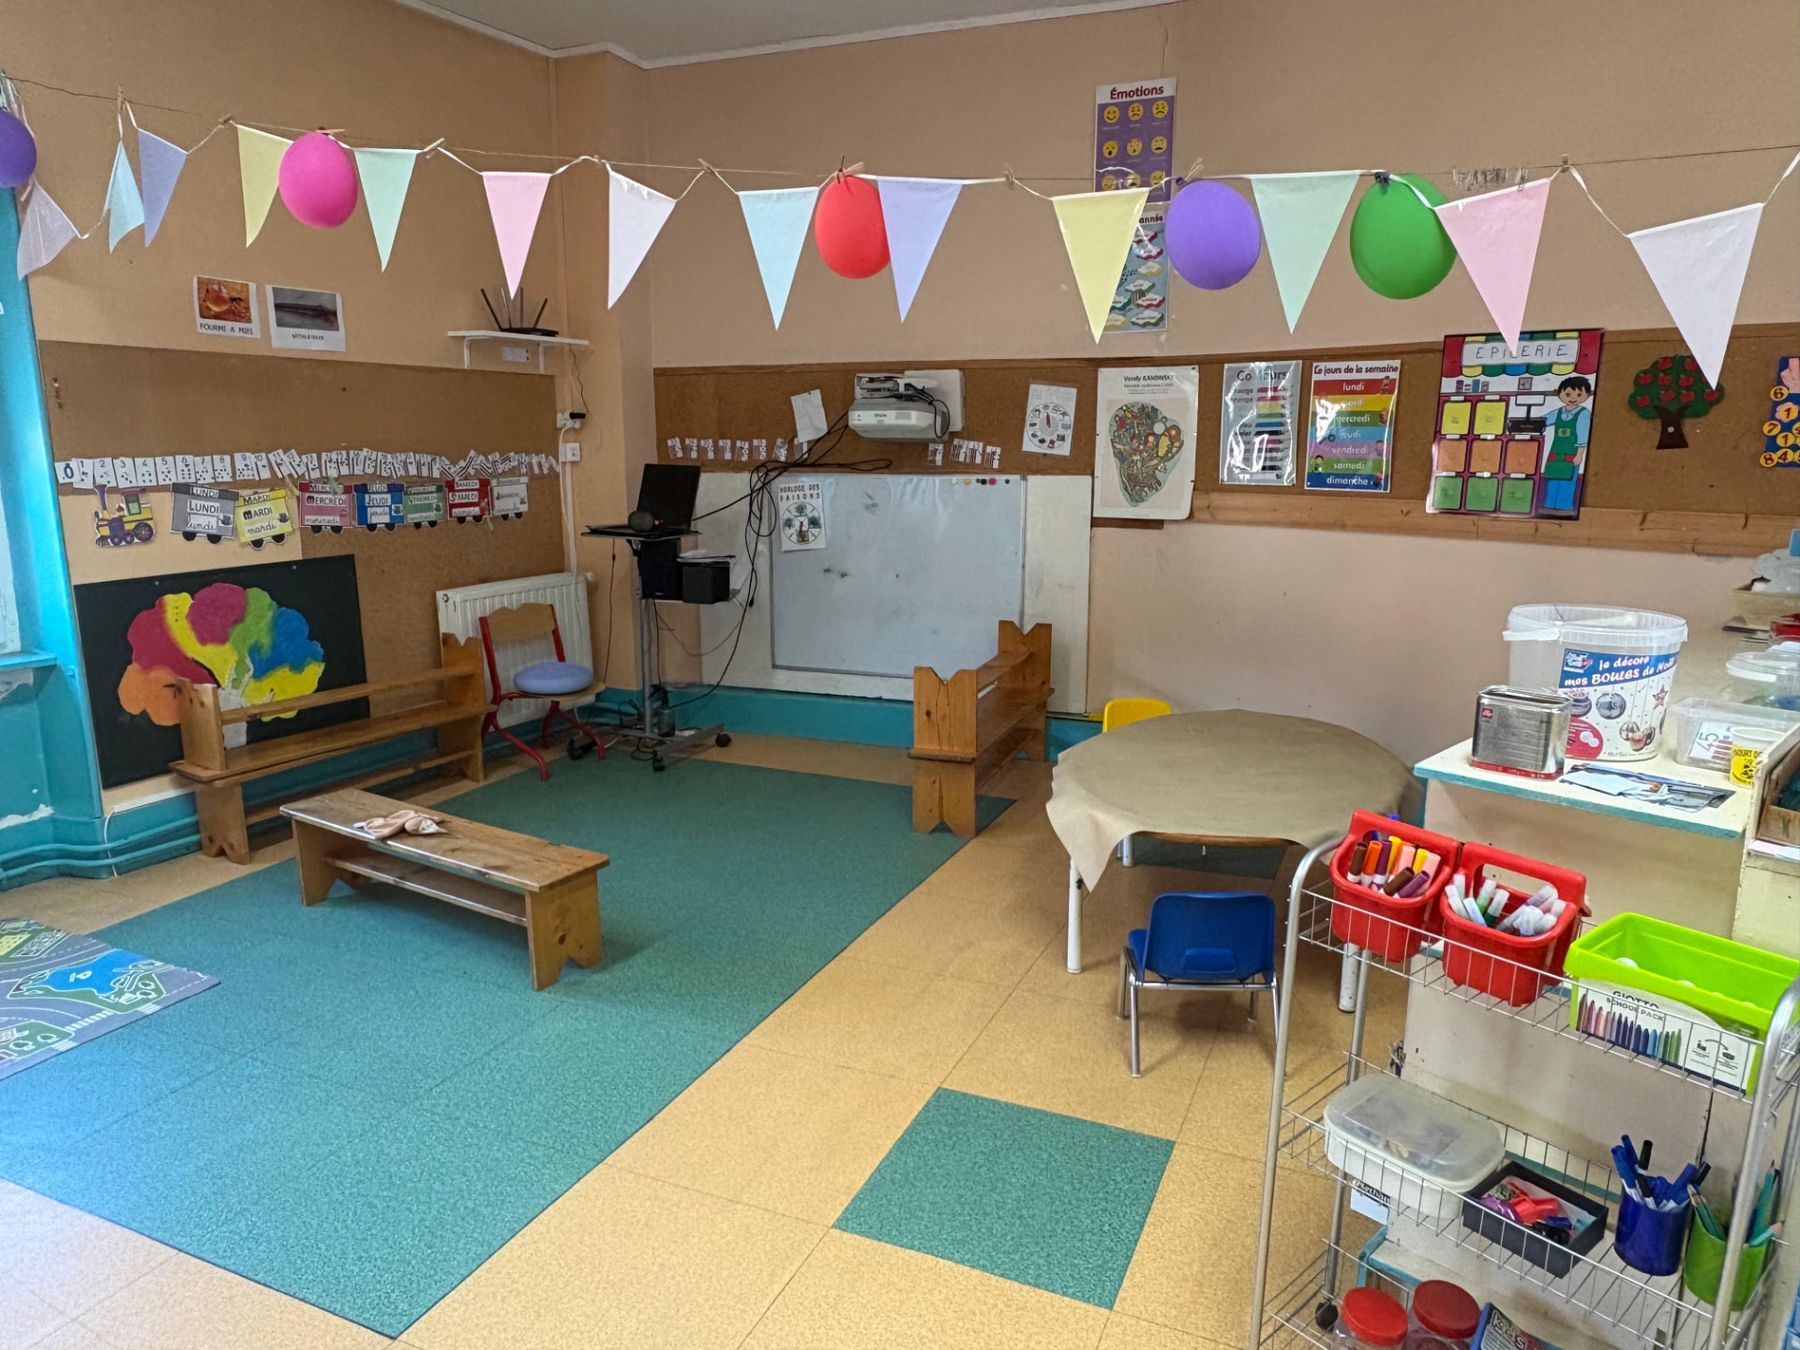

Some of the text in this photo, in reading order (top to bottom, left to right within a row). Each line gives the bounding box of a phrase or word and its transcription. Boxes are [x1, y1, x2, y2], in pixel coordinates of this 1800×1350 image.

[1110, 86, 1164, 100] Émotions
[200, 323, 227, 333] FOURMI
[239, 327, 253, 335] MIEL
[1324, 364, 1342, 376] jours
[1344, 365, 1353, 374] de
[1356, 364, 1363, 373] la
[1365, 364, 1398, 374] semaine
[1343, 383, 1365, 391] lundi
[1773, 387, 1784, 399] 6
[1334, 414, 1370, 423] mercredi
[1784, 407, 1792, 419] 1
[1767, 422, 1778, 434] 7
[1782, 434, 1788, 445] 1
[1331, 445, 1368, 454] vendredi
[254, 454, 263, 462] 10
[1763, 454, 1774, 464] 8
[1777, 451, 1788, 462] 4
[99, 460, 105, 468] 2
[119, 460, 126, 468] 3
[1333, 461, 1365, 470] samedi
[64, 463, 74, 479] 0
[1327, 476, 1369, 486] dimanche
[194, 487, 219, 498] LUNDI
[780, 492, 820, 502] SAISONS
[243, 494, 271, 505] MARDI
[366, 495, 389, 506] JEUDI
[189, 499, 219, 514] LUNDI
[1613, 656, 1649, 668] décore
[1564, 678, 1588, 687] mes
[1592, 669, 1640, 685] BOULES
[1642, 668, 1654, 677] de
[1606, 997, 1665, 1022] SCHOOL PACK
